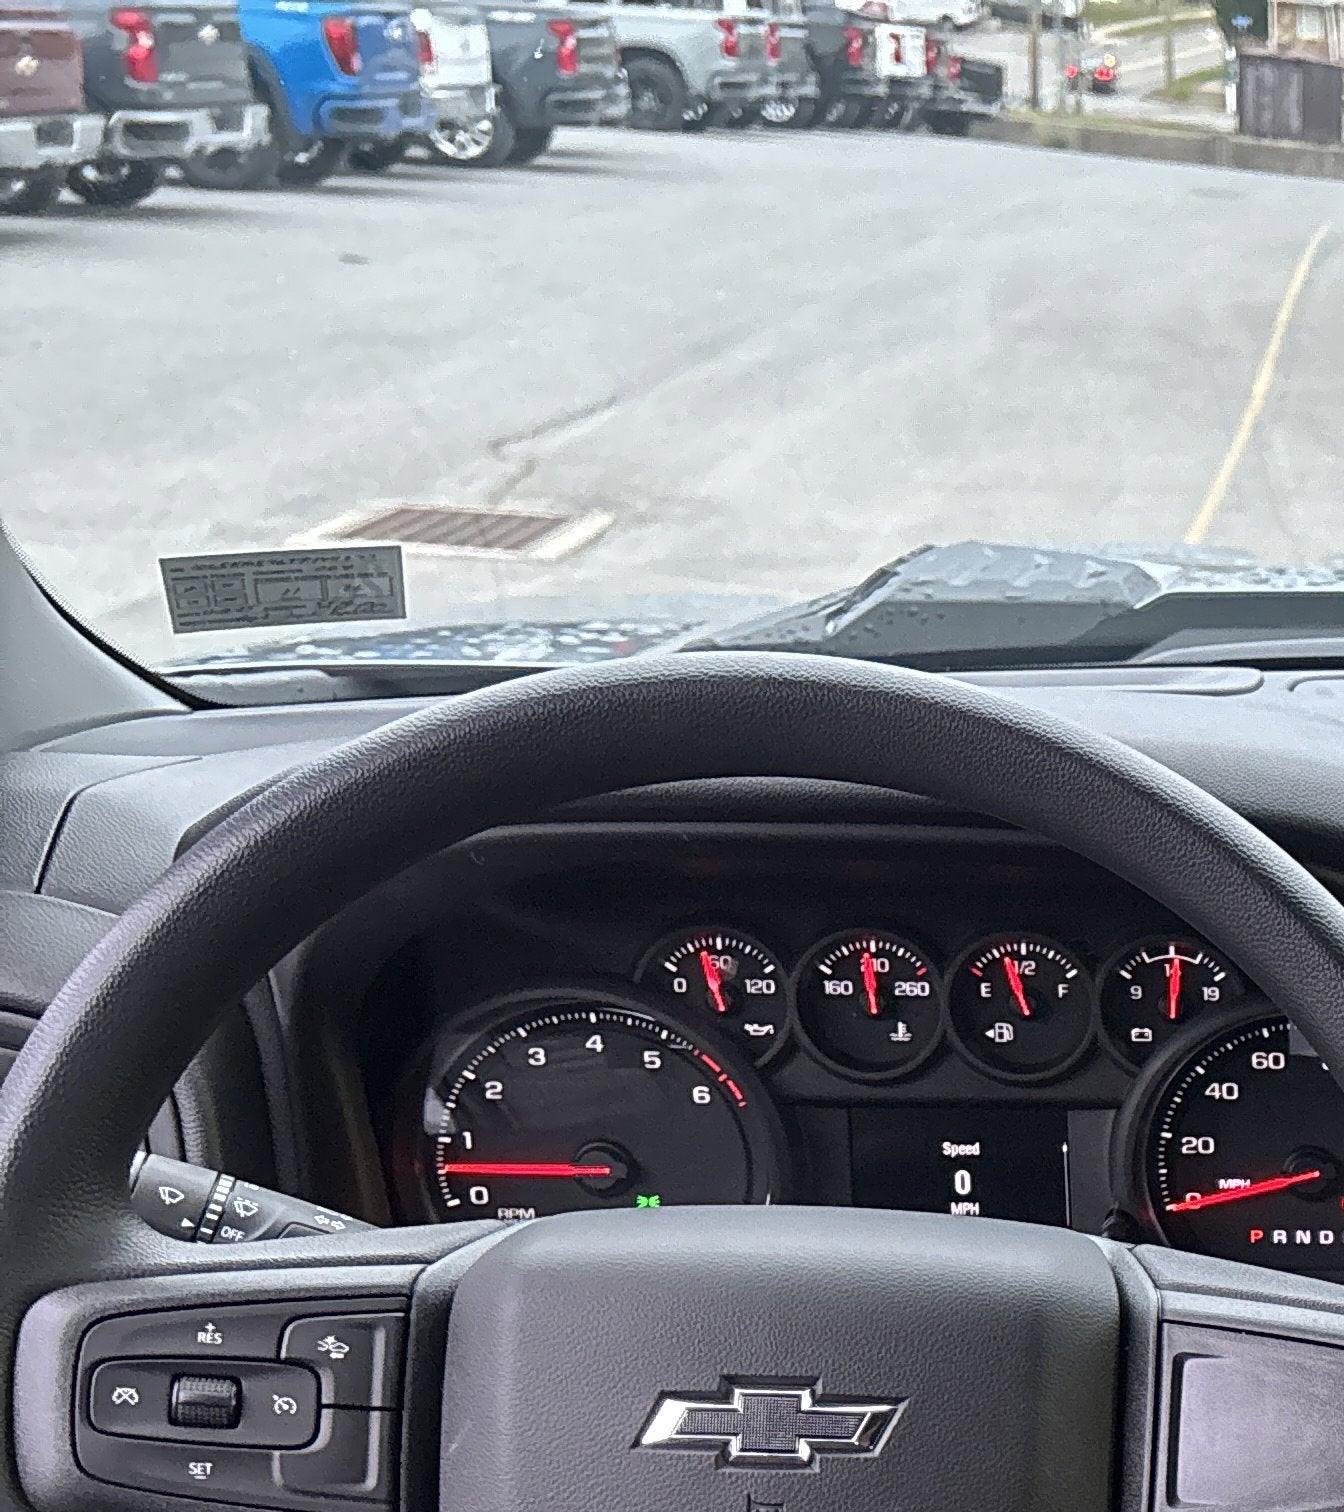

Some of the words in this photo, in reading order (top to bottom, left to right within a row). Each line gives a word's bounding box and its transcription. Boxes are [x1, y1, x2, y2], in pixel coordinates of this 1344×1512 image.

[673, 978, 687, 993] 0
[745, 979, 775, 994] 120
[823, 980, 853, 995] 160
[894, 981, 929, 996] 260
[980, 982, 992, 997] E
[1058, 984, 1069, 998] F
[1130, 986, 1142, 1000] 9
[1202, 987, 1220, 1001] 19
[585, 1035, 603, 1053] 4
[528, 1047, 546, 1066] 3
[644, 1051, 661, 1069] 5
[1251, 1052, 1286, 1069] 60
[485, 1081, 503, 1100] 2
[692, 1086, 711, 1104] 6
[1204, 1083, 1239, 1100] 40
[462, 1131, 473, 1149] 1
[1181, 1137, 1215, 1154] 20
[942, 1141, 980, 1158] Speed
[954, 1169, 971, 1195] 0
[1218, 1178, 1251, 1190] MPH
[469, 1186, 489, 1205] 0
[497, 1207, 536, 1219] RPM
[950, 1202, 980, 1216] MPH
[220, 1226, 245, 1242] OFF
[1250, 1230, 1264, 1243] P
[1273, 1230, 1287, 1243] R
[1295, 1230, 1311, 1244] N
[1319, 1230, 1334, 1244] D
[197, 1332, 223, 1344] RES
[188, 1462, 213, 1475] SET
